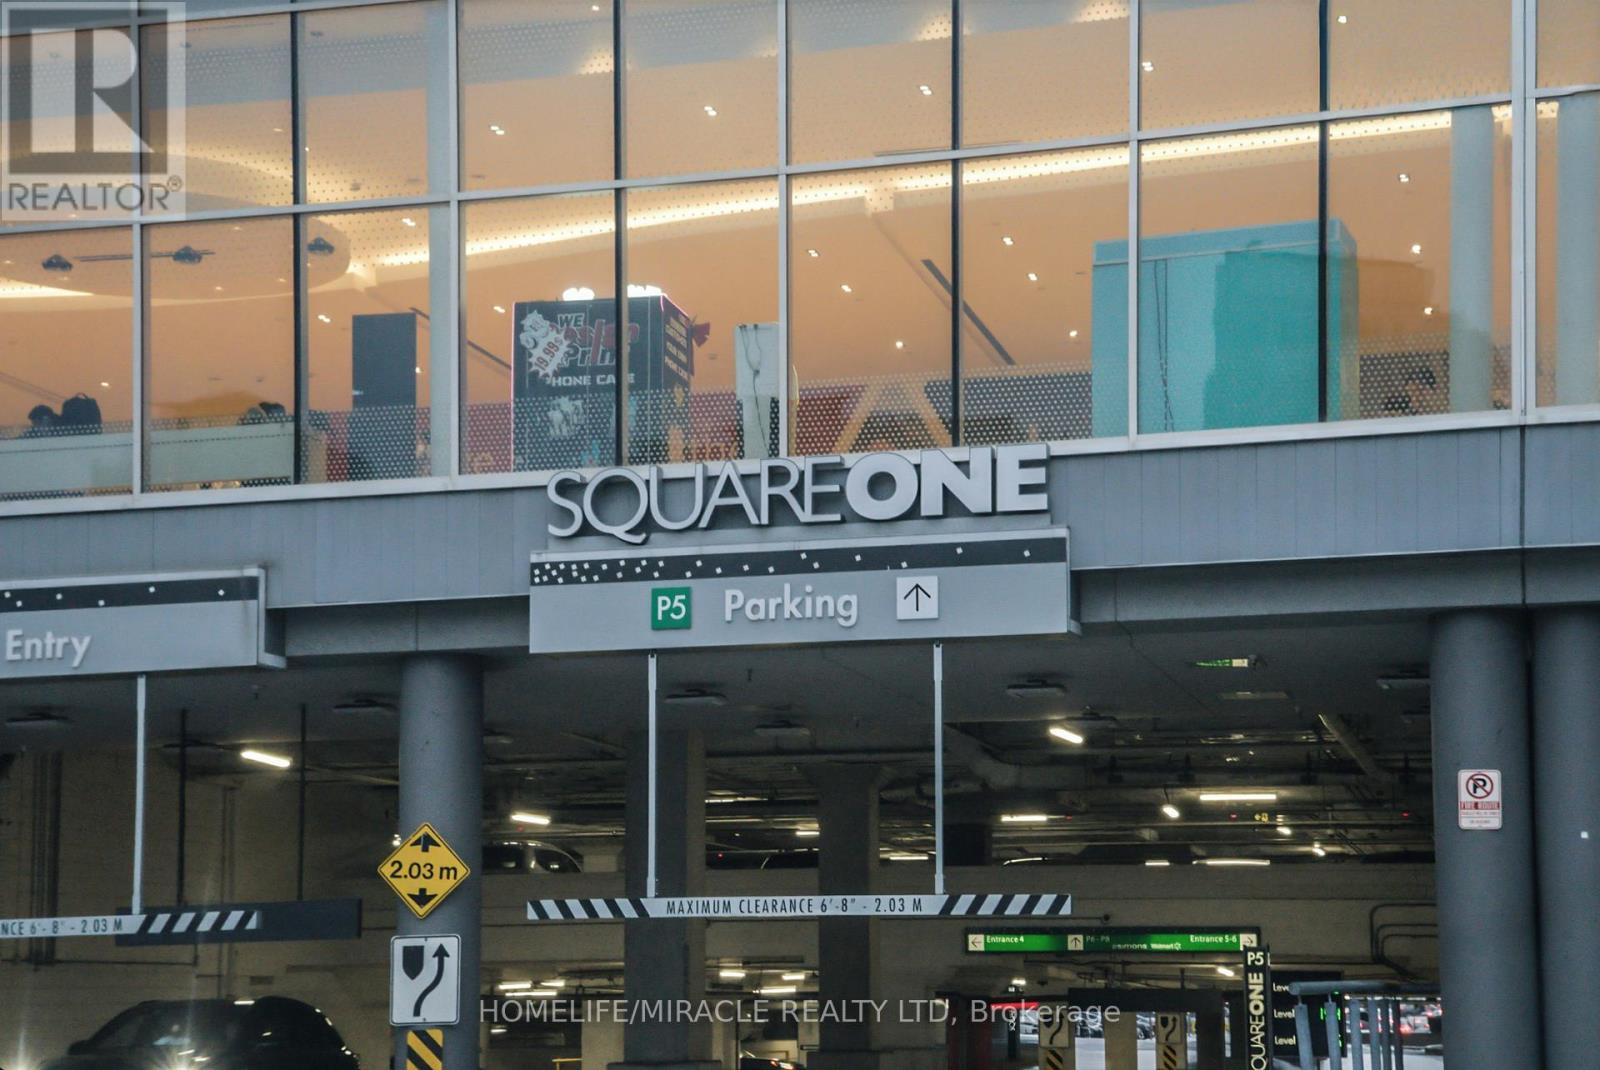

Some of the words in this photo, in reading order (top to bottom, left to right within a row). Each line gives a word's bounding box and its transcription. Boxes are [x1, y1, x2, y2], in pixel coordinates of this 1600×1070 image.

[557, 313, 585, 328] WE
[656, 595, 687, 621] P5
[724, 583, 859, 628] Parking
[5, 629, 91, 668] Entry
[390, 860, 434, 880] 2.03
[439, 866, 458, 880] m
[666, 900, 732, 915] MAXIMUM
[738, 898, 813, 914] CLEARANCE
[874, 898, 905, 913] 2.03
[912, 897, 922, 912] M
[113, 918, 122, 932] M
[986, 935, 1019, 943] Entrance
[1019, 935, 1025, 943] 4
[1190, 935, 1224, 943] Entrance
[1224, 934, 1238, 942] 5-6
[1247, 951, 1265, 966] P5
[1273, 1008, 1296, 1018] Level
[1274, 1035, 1297, 1045] Level
